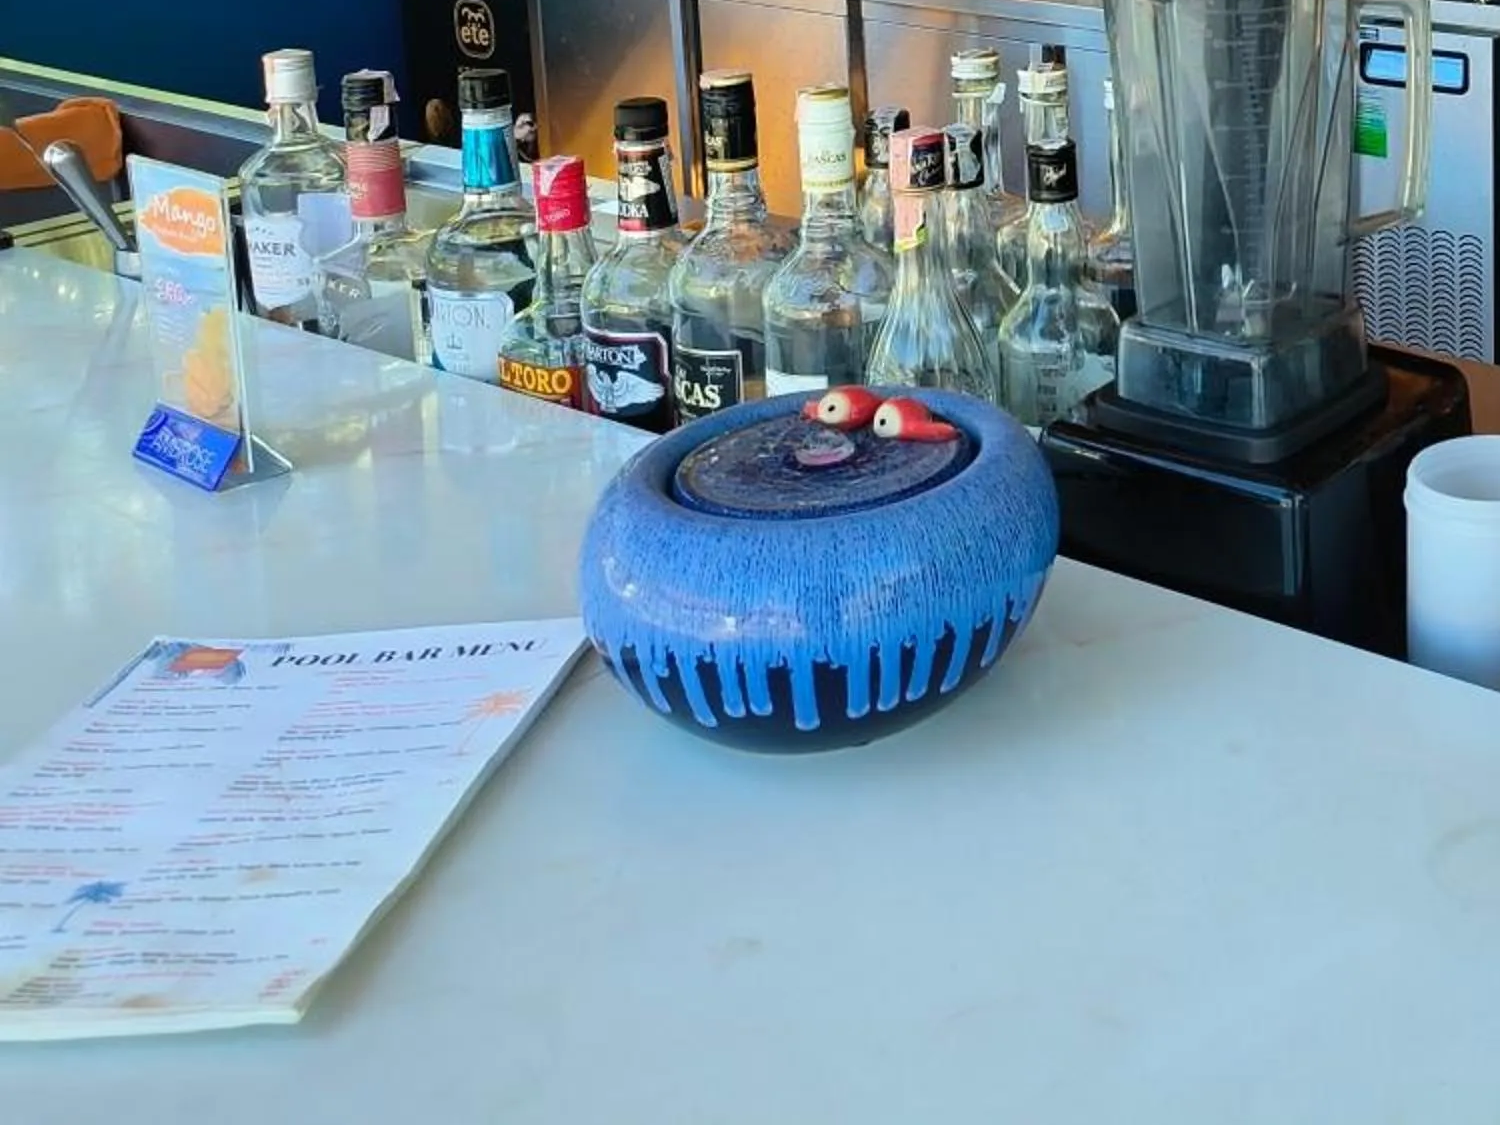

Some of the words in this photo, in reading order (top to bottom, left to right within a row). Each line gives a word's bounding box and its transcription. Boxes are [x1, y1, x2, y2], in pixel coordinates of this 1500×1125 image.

[152, 194, 216, 237] Mango
[252, 241, 297, 258] AKER
[510, 364, 573, 394] TORO
[271, 652, 361, 667] POOL
[373, 649, 442, 664] BAR
[449, 639, 547, 658] MENU
